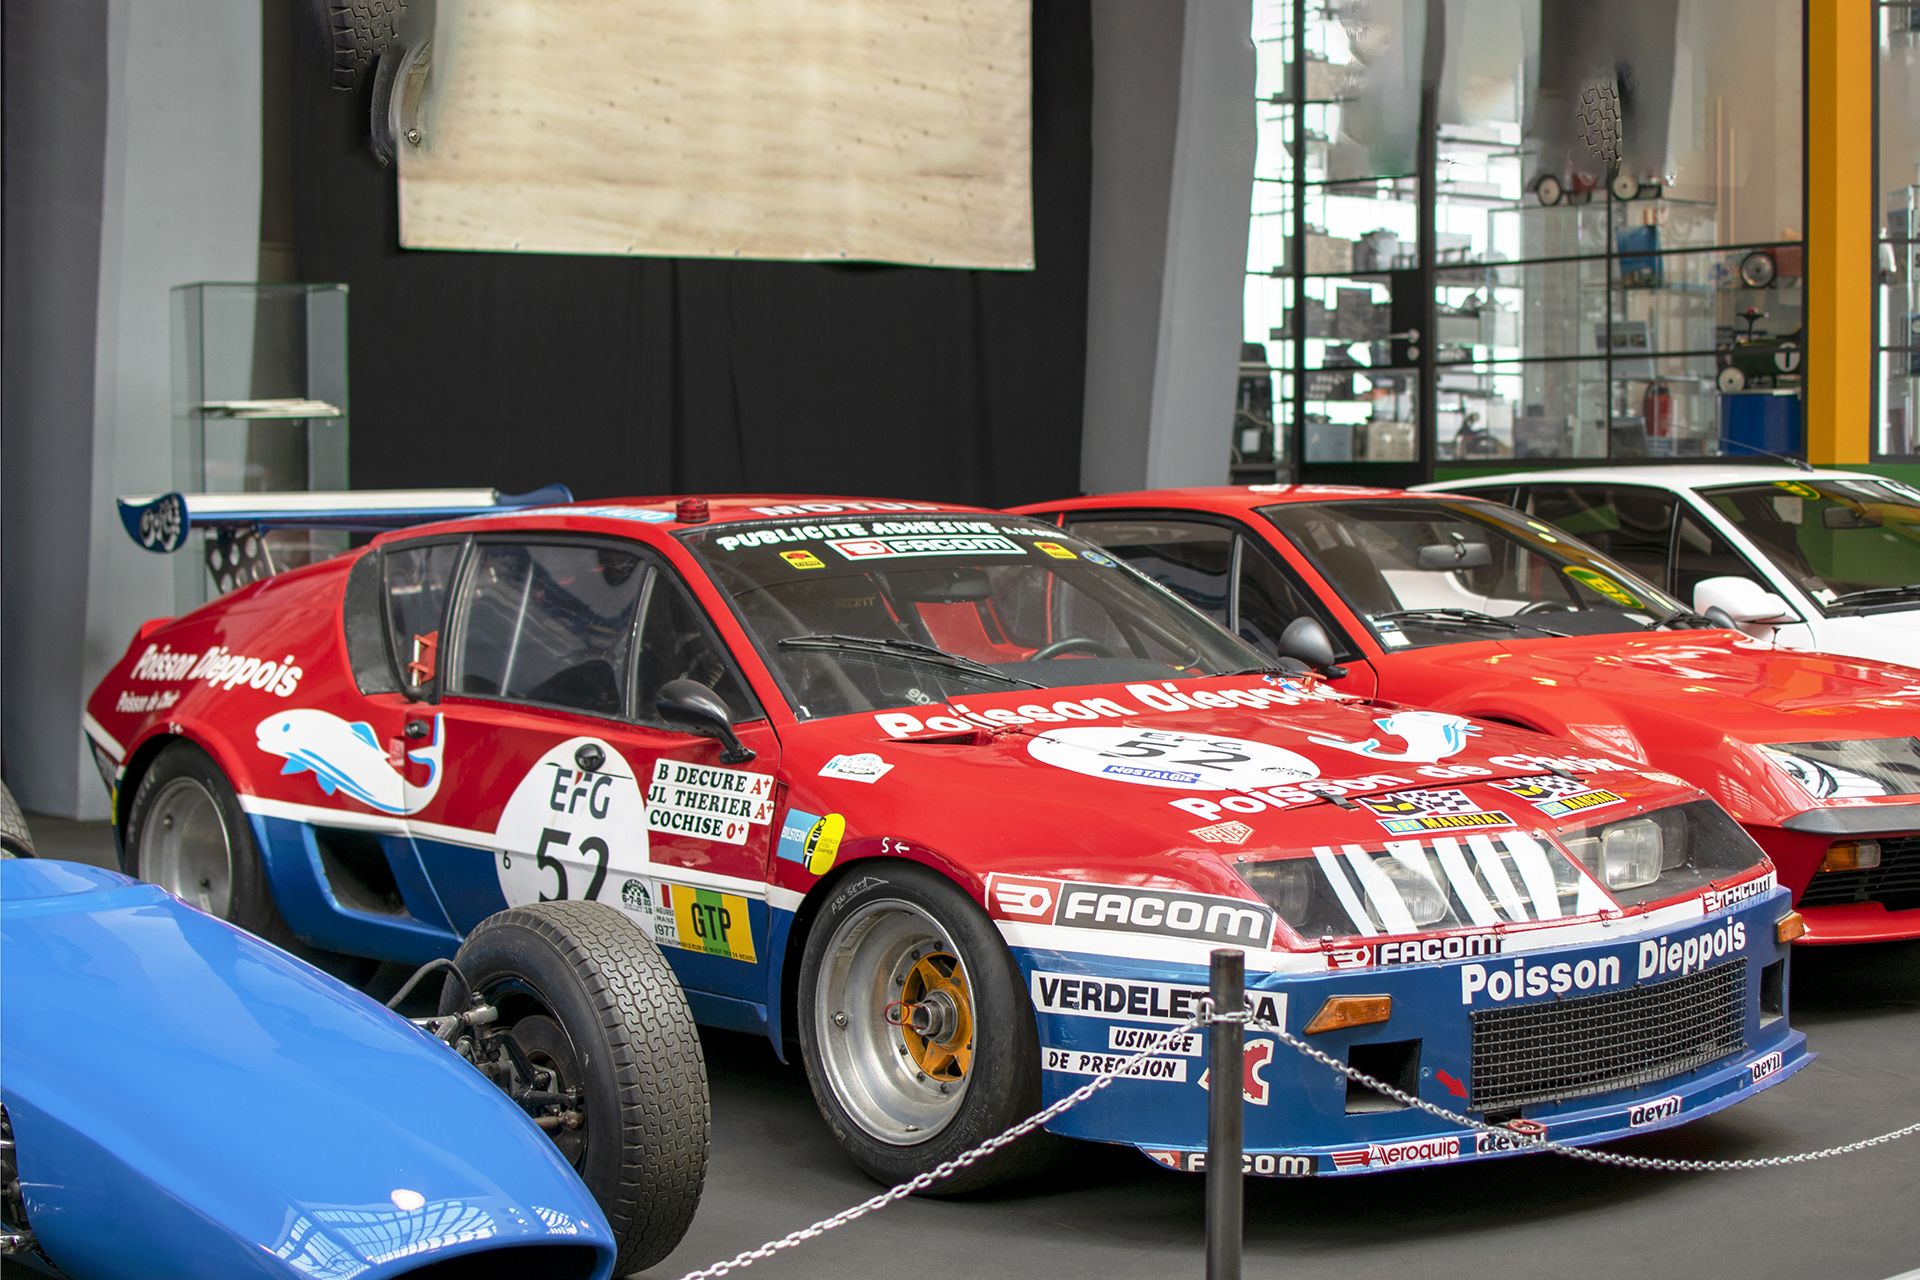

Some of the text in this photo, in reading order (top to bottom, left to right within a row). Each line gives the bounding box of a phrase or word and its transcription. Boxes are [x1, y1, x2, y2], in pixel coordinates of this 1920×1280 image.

[750, 502, 938, 517] MOTUL
[716, 523, 869, 551] PUBLICITE
[872, 521, 1000, 535] ADHESIVE
[889, 538, 1012, 553] FACOM
[130, 643, 303, 697] Poisson Dieppois
[874, 696, 1139, 738] Poisson
[1098, 740, 1251, 772] 52
[657, 763, 771, 795] B DECURE A+
[1109, 765, 1196, 783] NOSTALGIE
[647, 785, 774, 820] JL THERIER A+
[1168, 774, 1414, 821] Poisson
[1416, 762, 1493, 778] de
[1560, 791, 1619, 810] MARCHAL
[649, 809, 723, 837] COCHISE
[780, 826, 808, 844] BILSTEIN
[1420, 813, 1508, 829] MARCHAL
[881, 836, 890, 853] S
[502, 850, 511, 870] 6
[536, 827, 609, 902] 52
[621, 893, 642, 906] 6-7-8
[690, 902, 732, 943] GTP
[1064, 891, 1265, 940] FACOM
[654, 923, 675, 937] 1977
[1380, 934, 1497, 965] FACOM
[1461, 916, 1746, 1004] Poisson Dieppois
[1114, 1029, 1194, 1052] USINAGE
[1049, 1051, 1070, 1069] DE
[1753, 1053, 1781, 1080] devil
[1632, 1097, 1678, 1125] devil
[1369, 1137, 1459, 1165] Aeroquip
